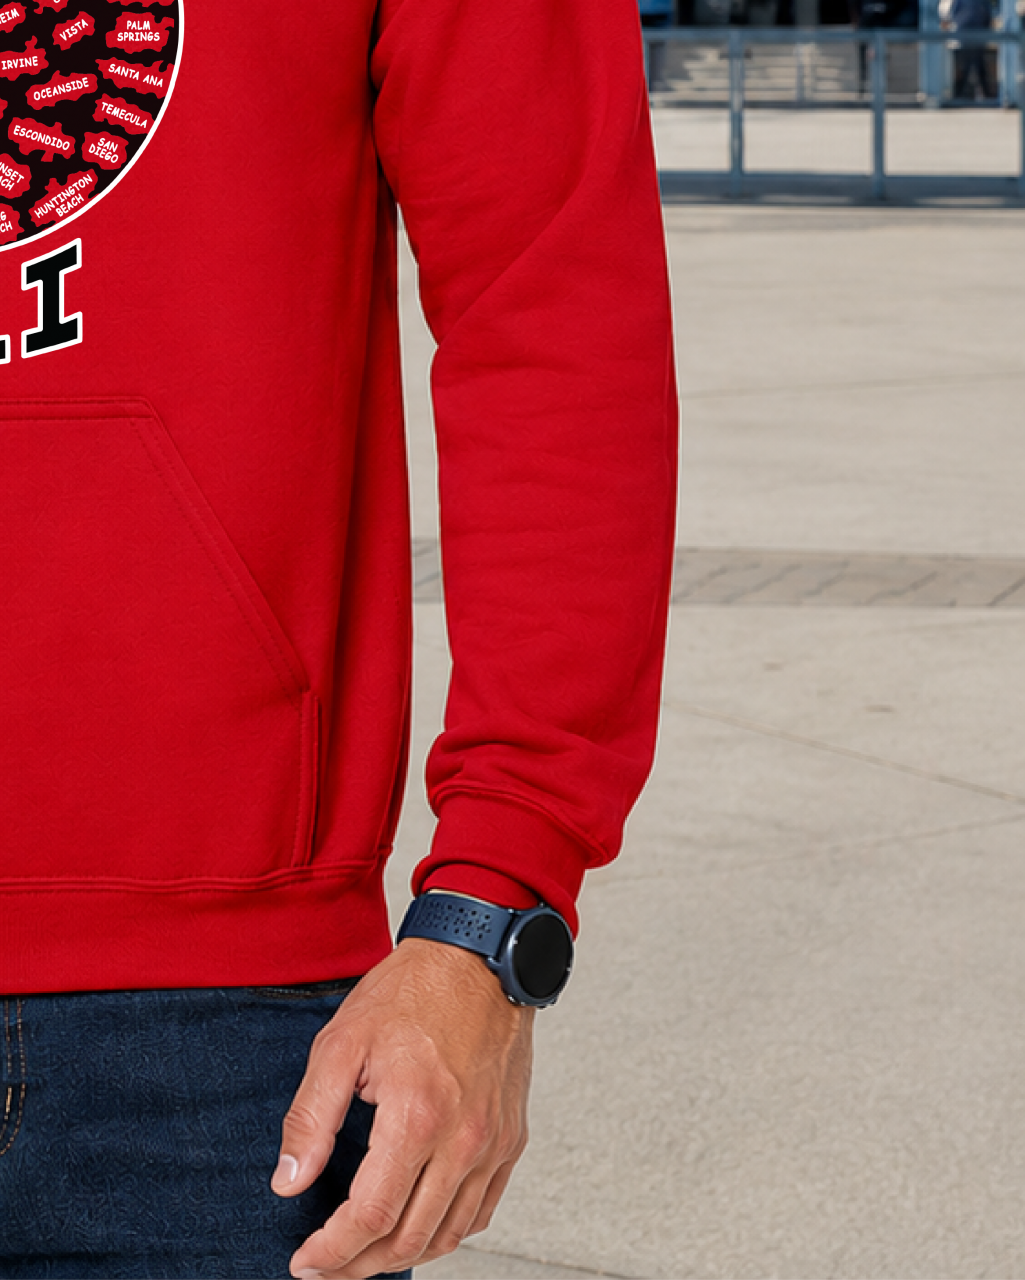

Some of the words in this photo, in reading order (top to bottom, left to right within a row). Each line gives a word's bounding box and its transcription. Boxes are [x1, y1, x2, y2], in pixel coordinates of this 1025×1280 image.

[59, 18, 89, 41] VISTA
[116, 31, 161, 42] SPRINGS
[126, 19, 151, 31] PALM
[1, 55, 39, 71] IRVINE
[108, 63, 140, 81] SANTA
[142, 74, 164, 88] ANA
[33, 76, 90, 101] OCEANSIDE
[101, 101, 148, 129] TEMECULA
[13, 124, 71, 151] ESCONDIDO
[97, 137, 119, 153] SAN
[88, 143, 119, 164] DIEGO
[33, 173, 93, 219] HUNTINGTON
[55, 193, 85, 218] BEACH
